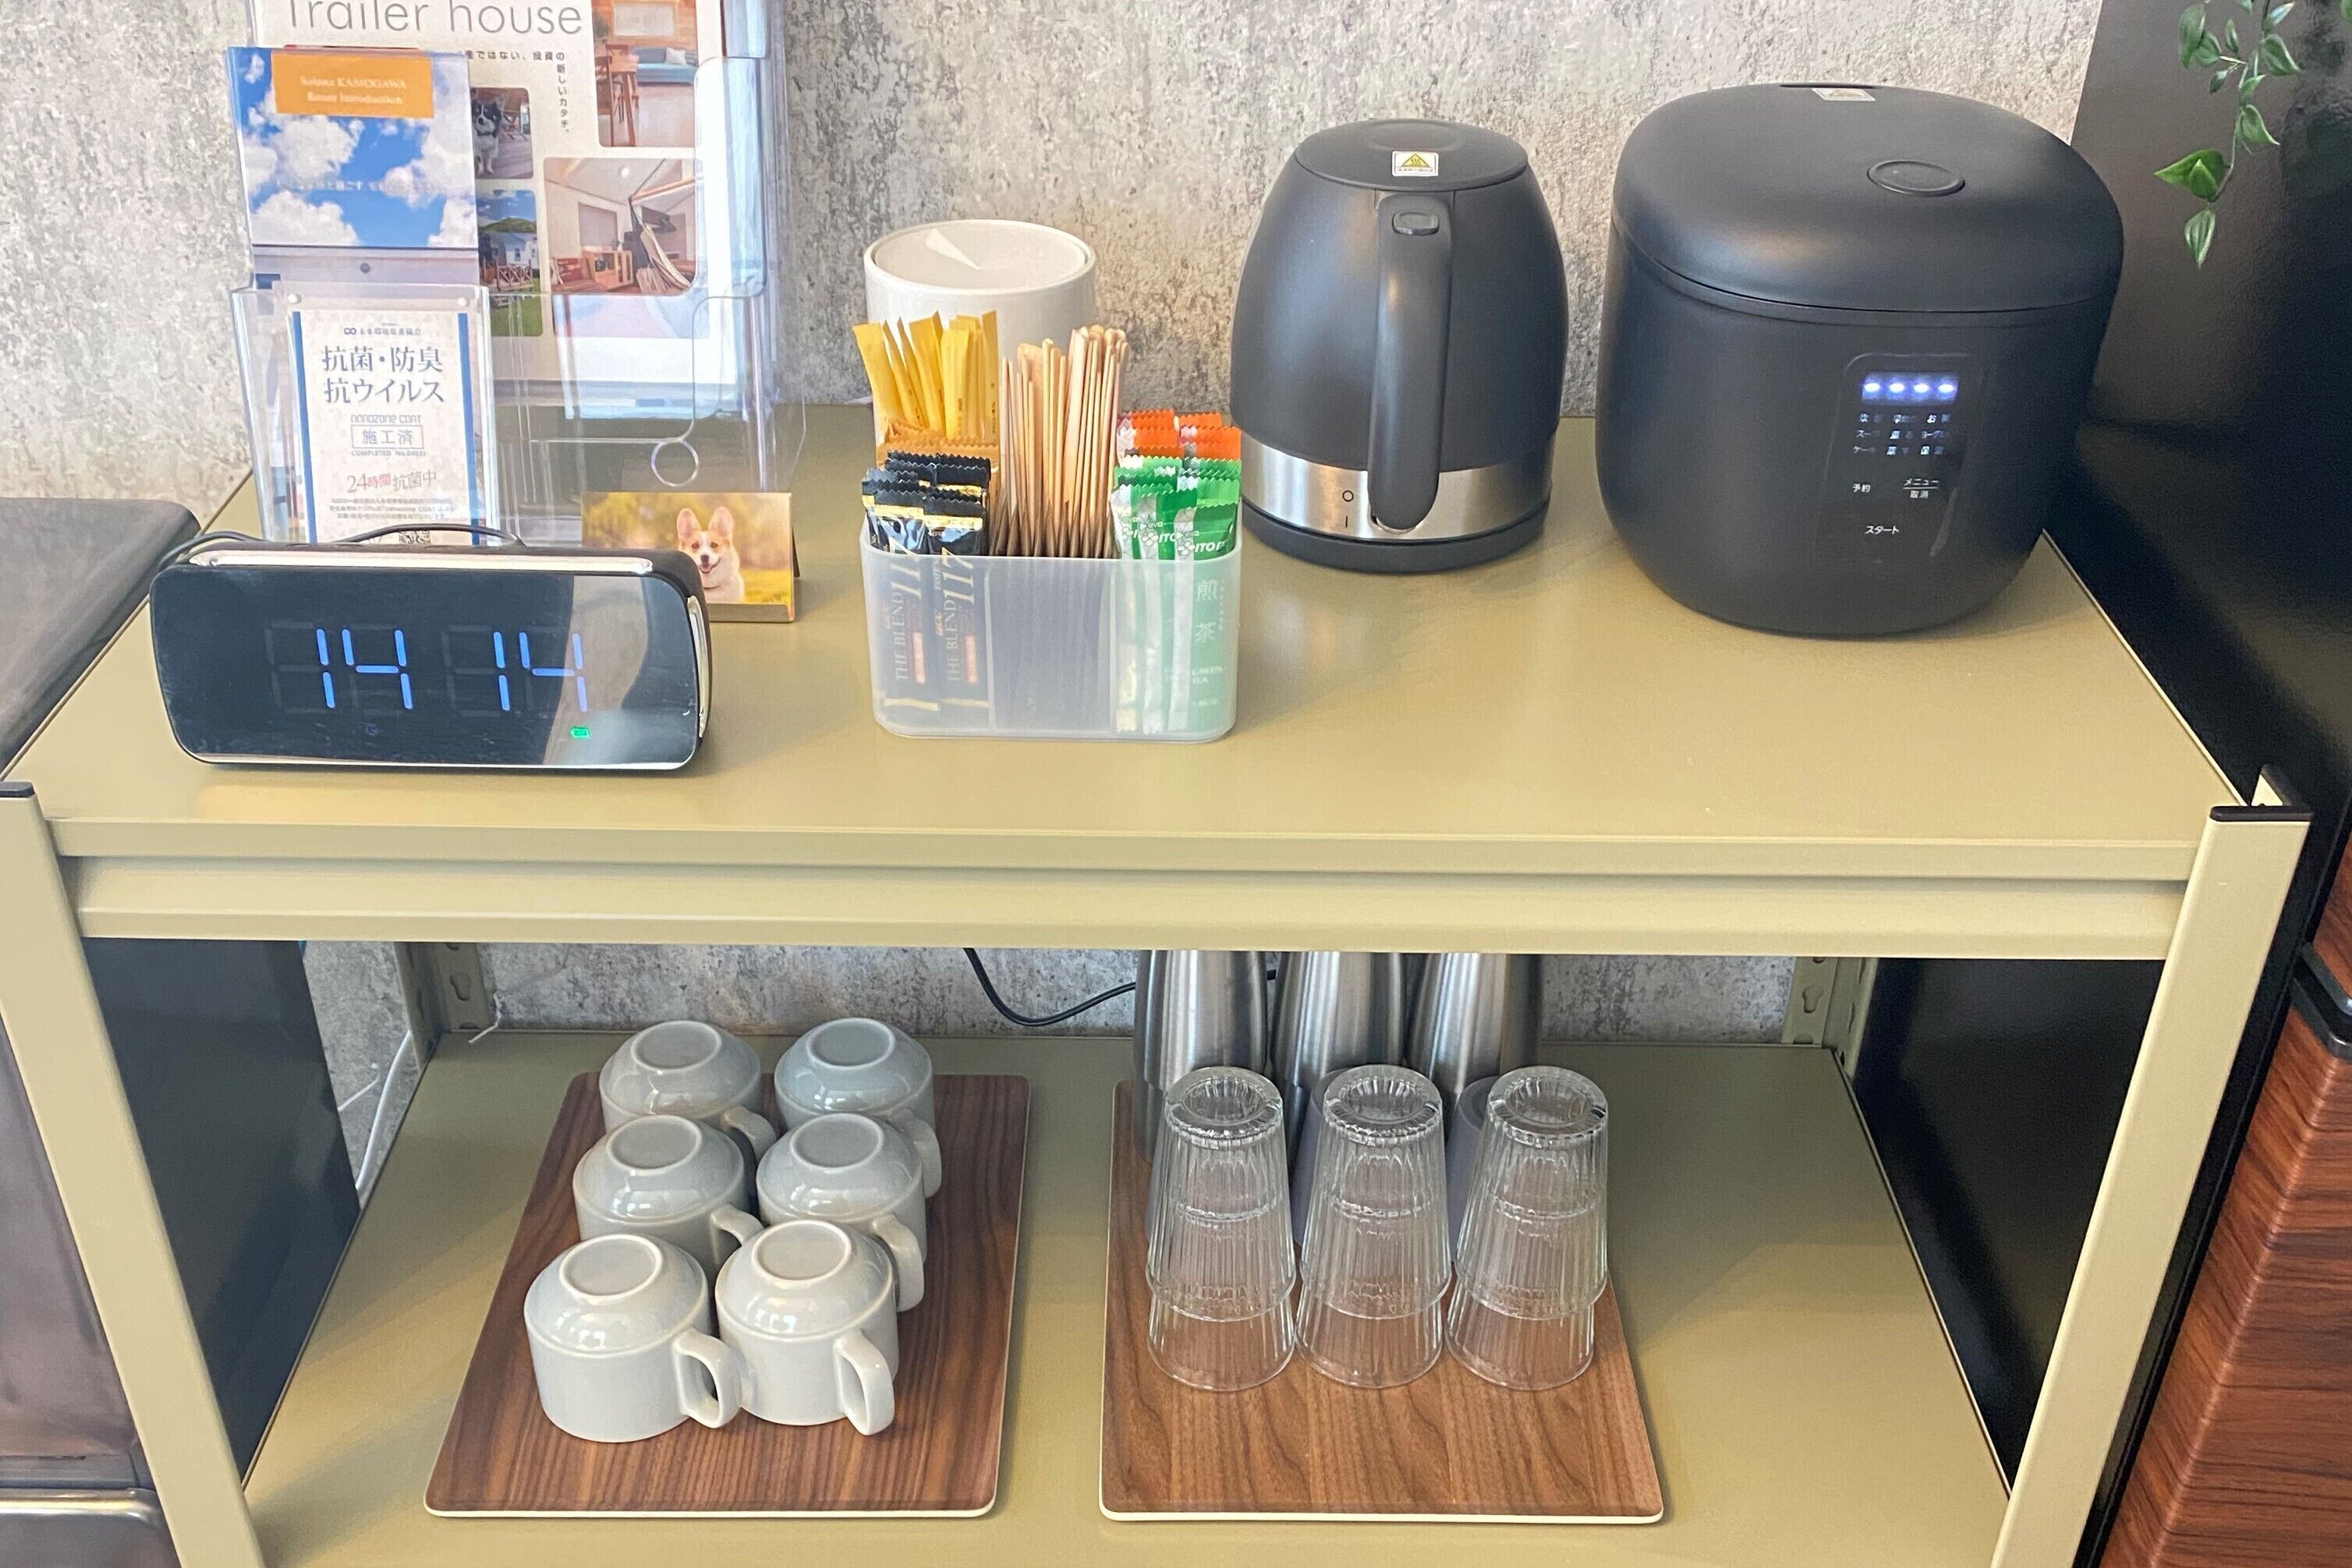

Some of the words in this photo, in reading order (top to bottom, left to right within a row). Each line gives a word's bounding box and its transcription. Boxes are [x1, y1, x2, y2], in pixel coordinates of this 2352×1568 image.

[450, 0, 582, 34] house
[322, 346, 443, 373] 抗菌・防臭
[324, 377, 445, 403] 抗ウイルス
[362, 429, 413, 445] 施工済
[1852, 483, 1871, 493] 予約
[1904, 477, 1939, 487] メニュー
[1865, 525, 1900, 535] スタート
[941, 547, 975, 605] 117
[891, 592, 906, 646] BLEND
[944, 600, 959, 649] BLEND
[1195, 579, 1218, 643] 煎茶
[316, 627, 414, 709] 14
[493, 631, 587, 713] 14
[894, 651, 908, 681] THE
